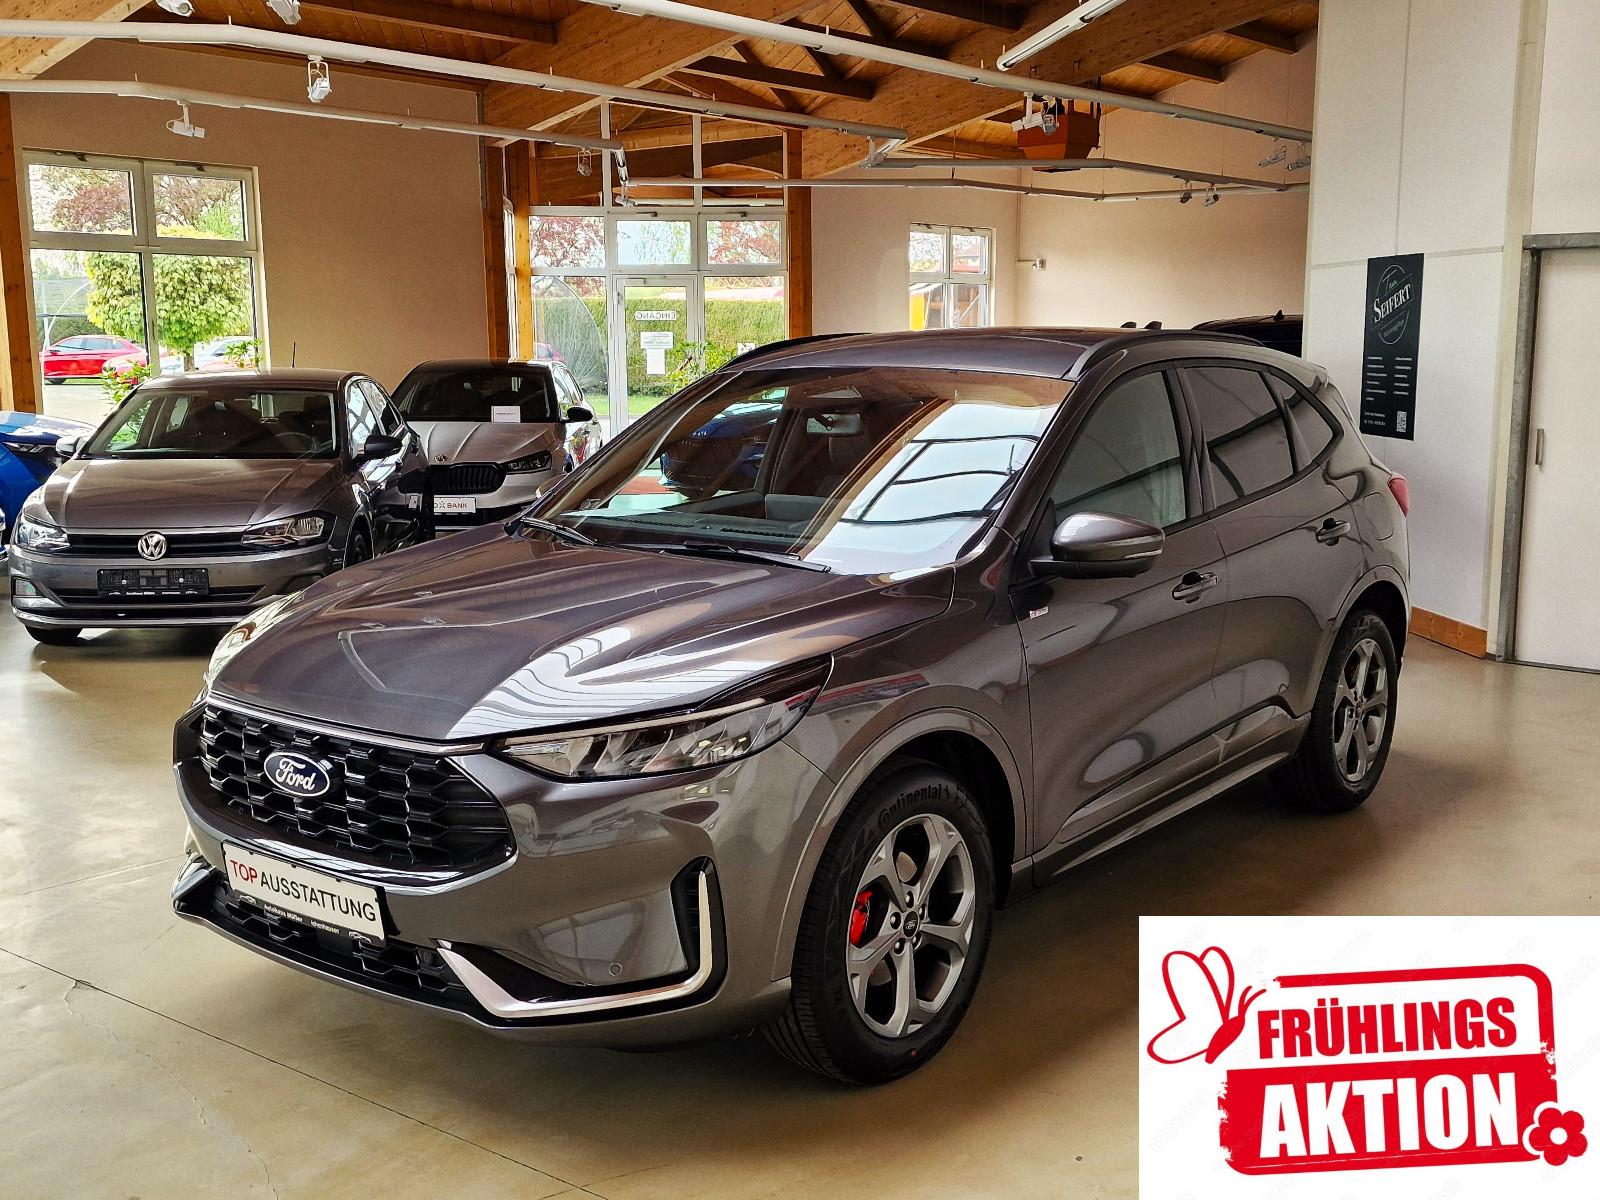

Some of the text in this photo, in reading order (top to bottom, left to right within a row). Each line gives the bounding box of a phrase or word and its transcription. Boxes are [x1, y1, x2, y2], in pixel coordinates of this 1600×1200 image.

[1373, 284, 1411, 323] SEIFERT
[275, 758, 316, 791] Ford
[878, 783, 942, 824] Continental
[230, 859, 377, 922] TOP AUSSTATTUNG
